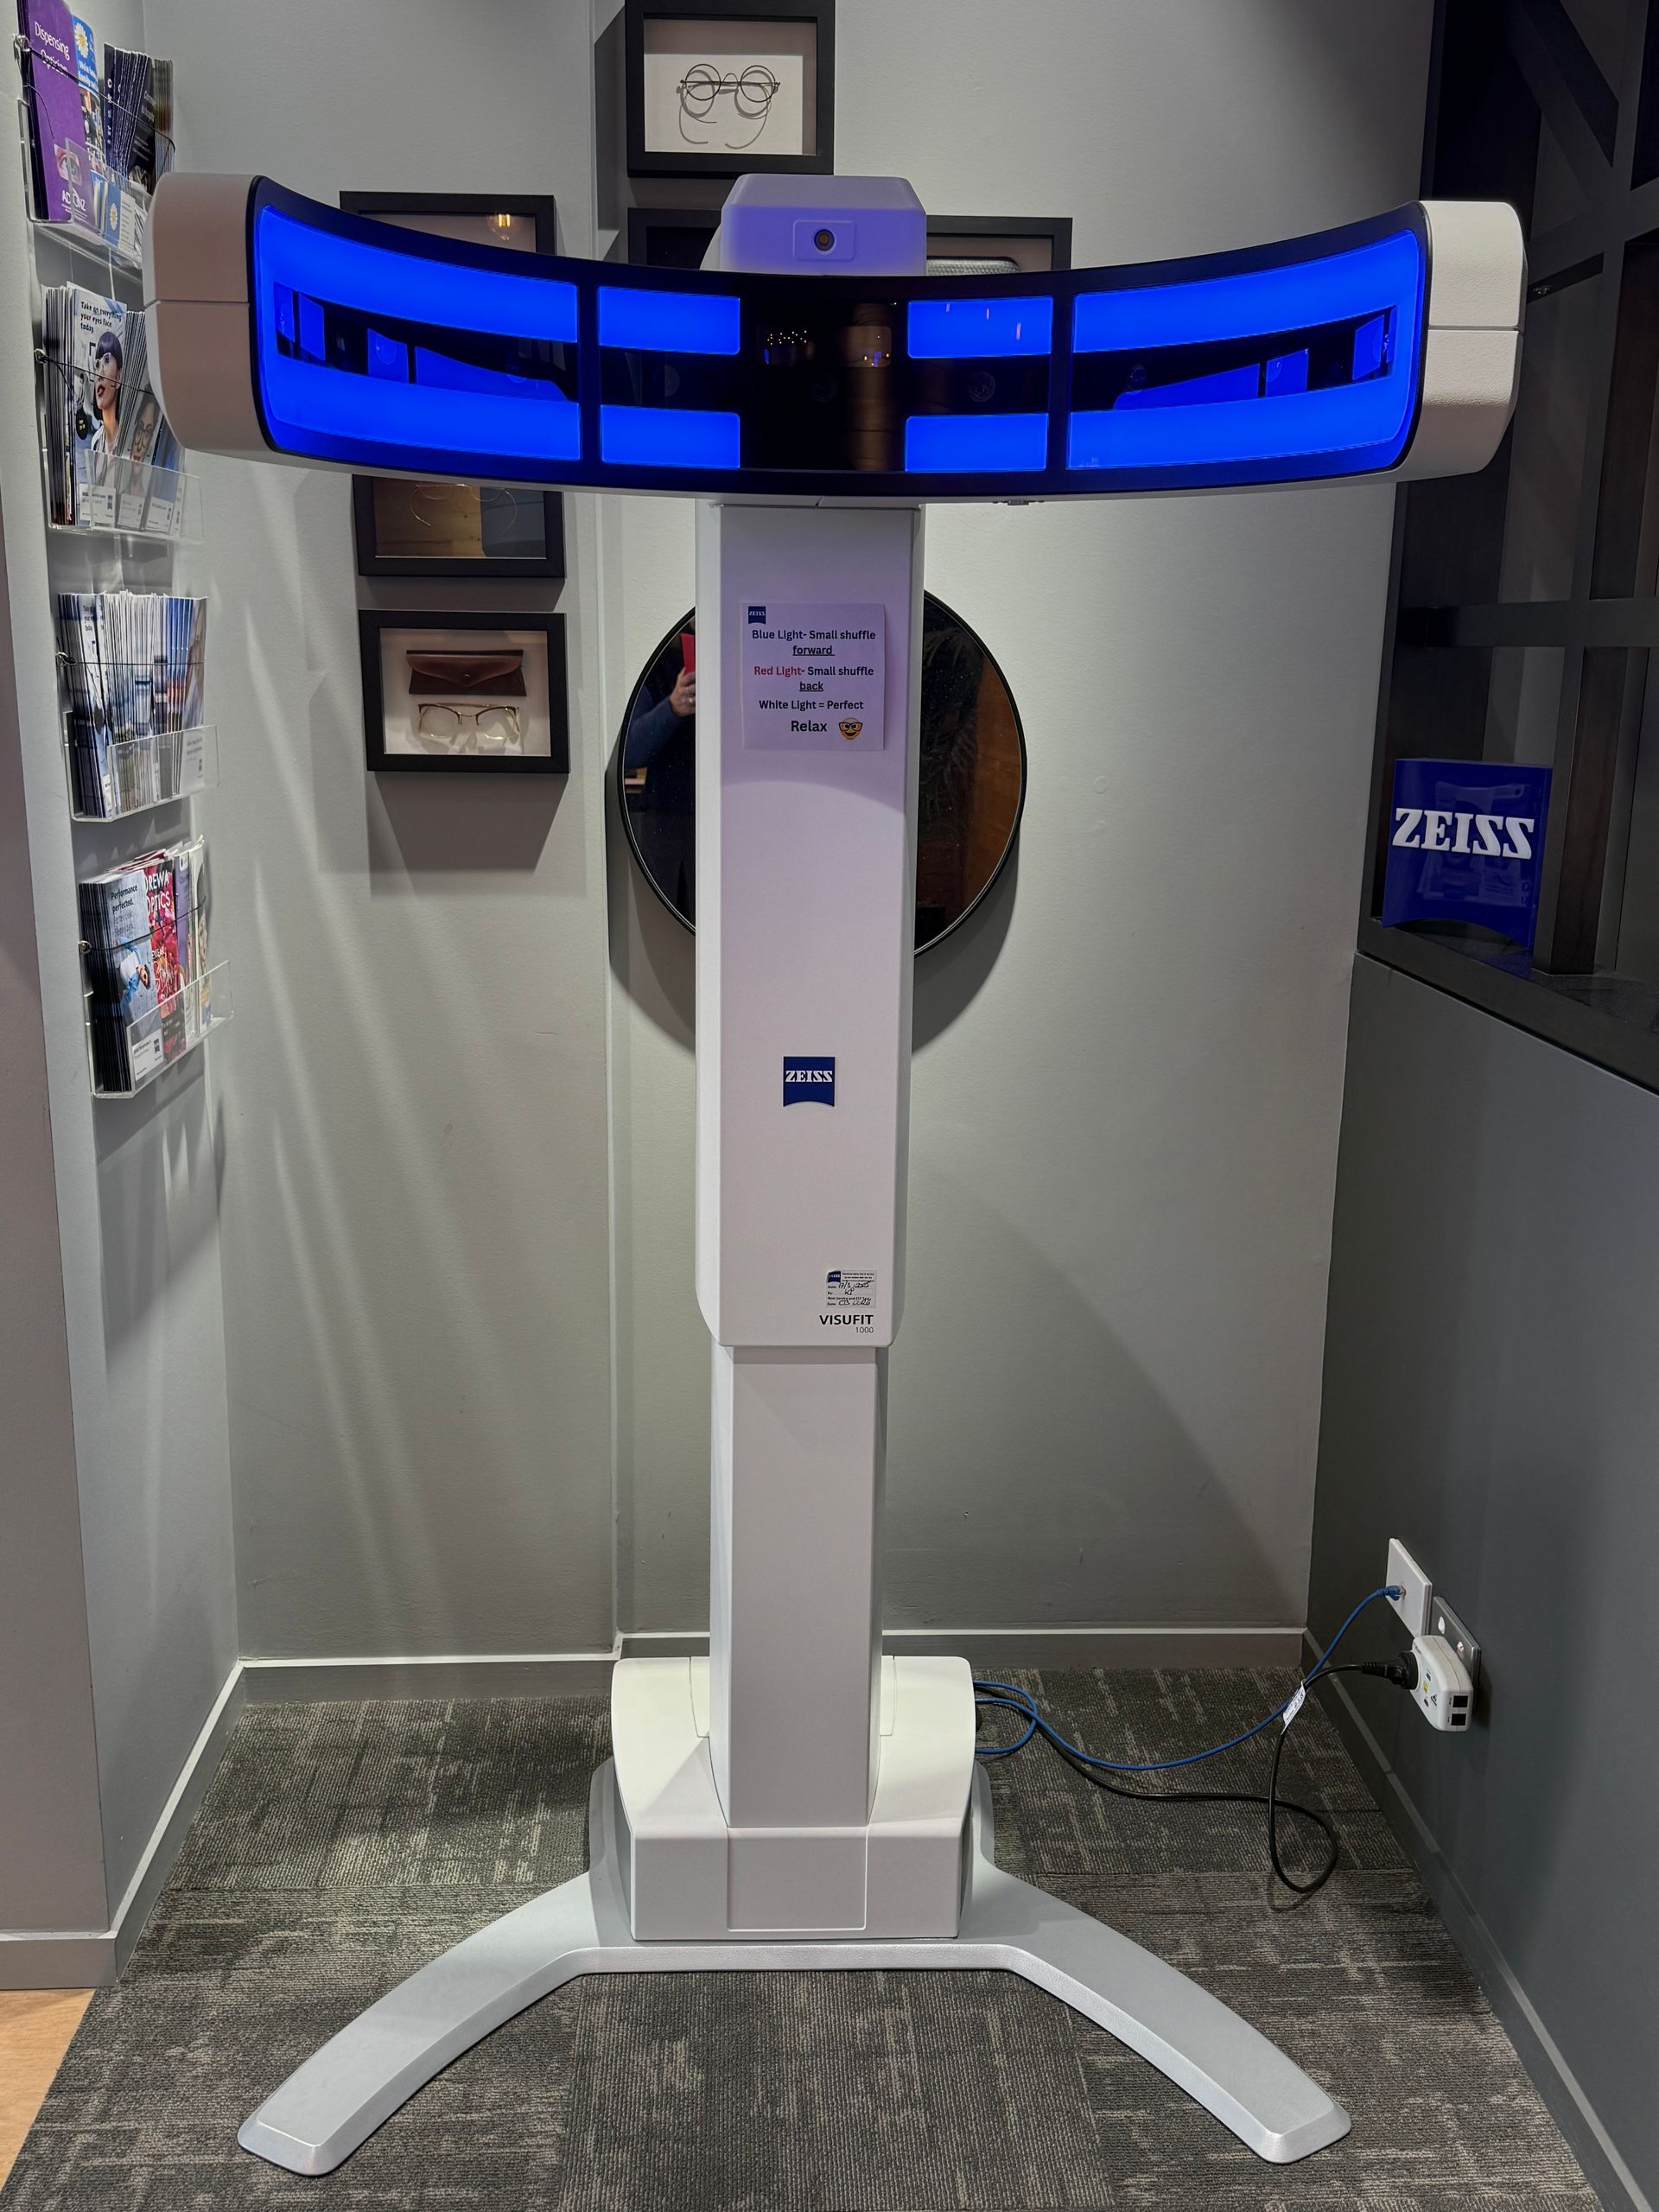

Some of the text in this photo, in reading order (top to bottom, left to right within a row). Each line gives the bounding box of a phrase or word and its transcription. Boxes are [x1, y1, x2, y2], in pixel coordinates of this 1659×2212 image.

[35, 22, 70, 60] Dispensing
[81, 302, 92, 311] Take
[752, 630, 876, 641] Blue Light- Small shuffle
[792, 645, 832, 656] forward
[753, 665, 874, 677] Red Light- Small shuffle
[799, 681, 823, 691] back
[759, 700, 789, 709] White
[791, 700, 817, 712] Light
[827, 700, 864, 709] Perfect
[791, 720, 828, 733] Relax
[1392, 807, 1535, 860] ZEISS
[111, 884, 138, 900] Performance
[785, 1070, 833, 1083] ZEISS
[819, 1314, 874, 1325] VISUFIT
